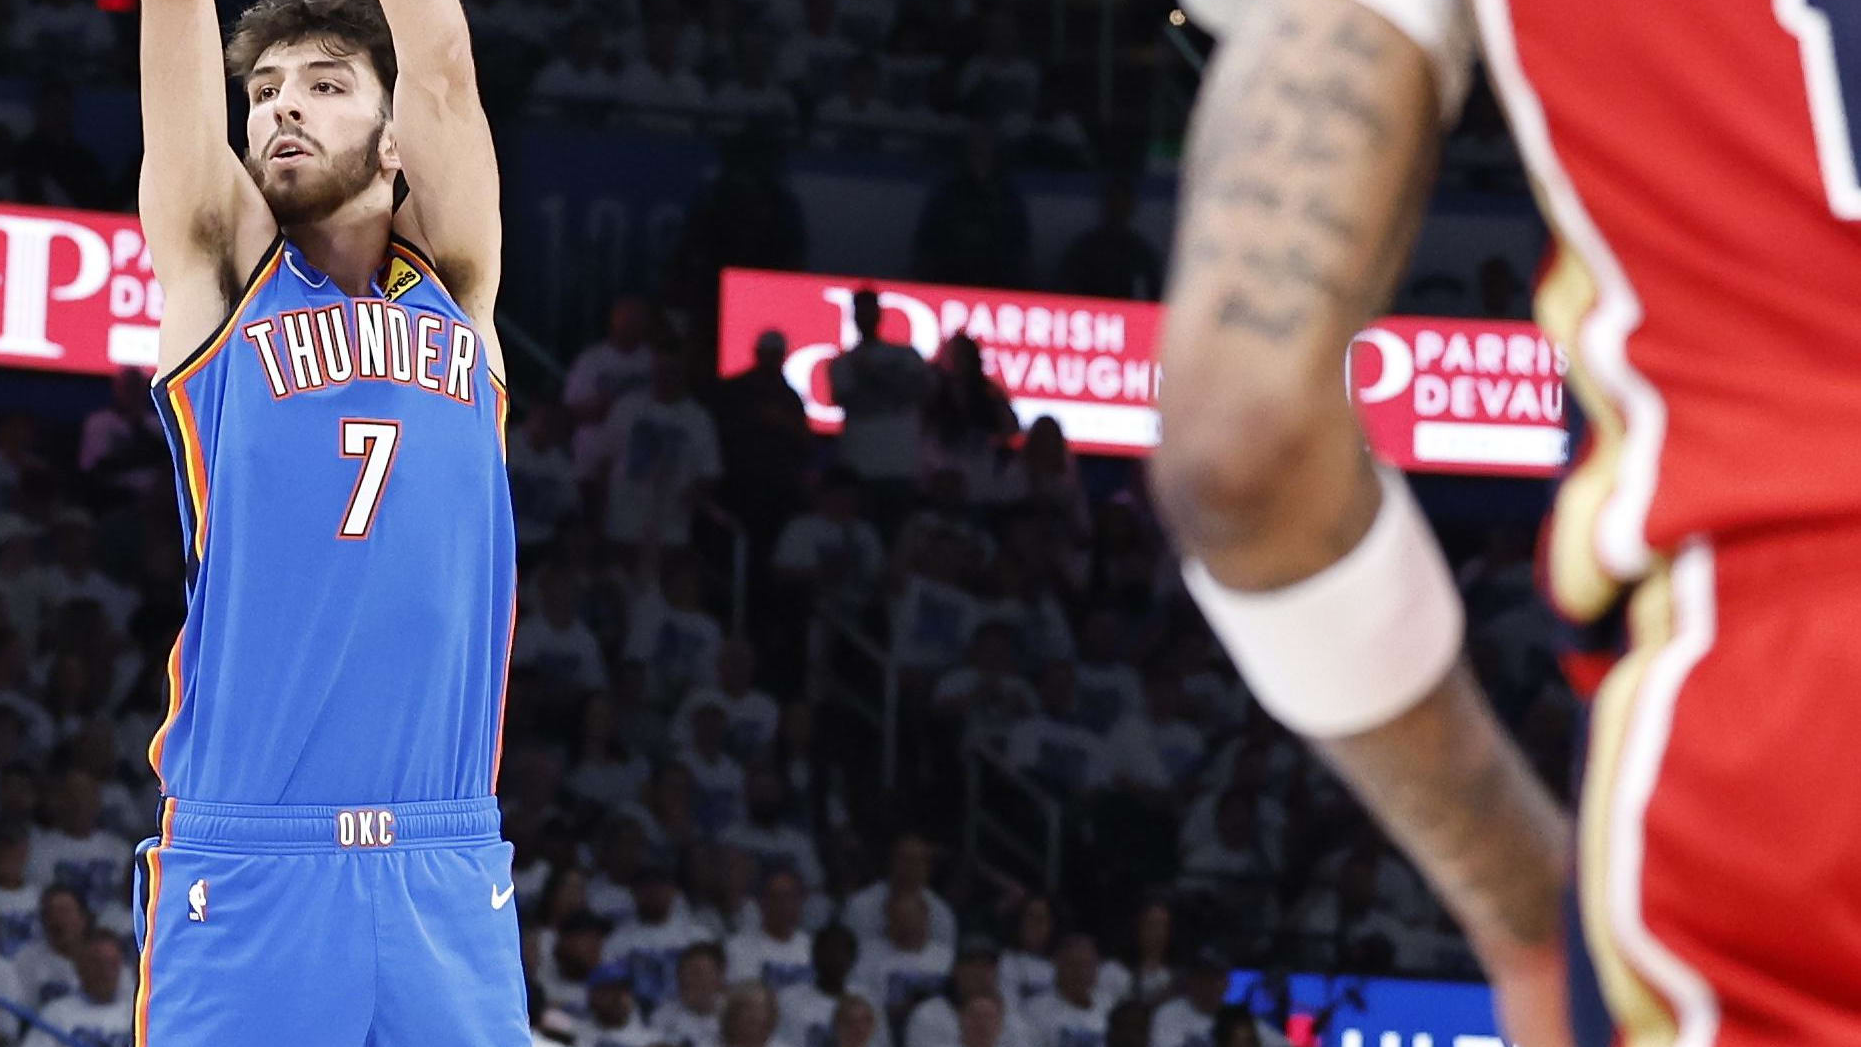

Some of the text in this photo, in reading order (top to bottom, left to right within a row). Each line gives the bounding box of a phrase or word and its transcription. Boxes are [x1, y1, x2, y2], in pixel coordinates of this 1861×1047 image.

[242, 297, 479, 406] THUNDER
[940, 299, 1125, 353] PARRISH
[335, 418, 402, 541] 7
[335, 808, 396, 848] OKC
